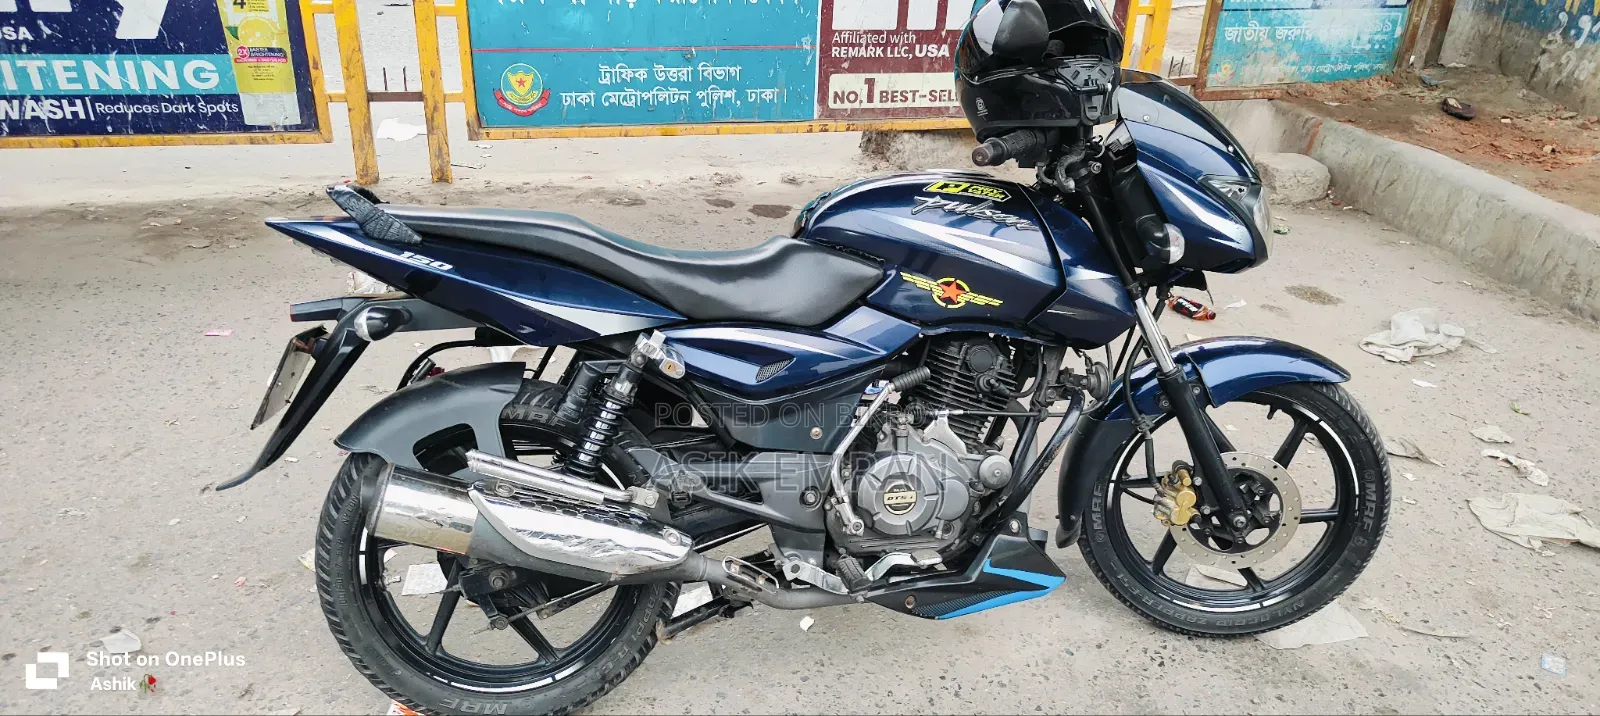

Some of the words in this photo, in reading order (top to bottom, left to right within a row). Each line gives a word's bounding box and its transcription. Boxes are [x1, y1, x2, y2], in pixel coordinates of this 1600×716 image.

[0, 26, 34, 40] SA
[832, 31, 886, 43] Affiliated
[890, 32, 916, 43] with
[237, 48, 249, 56] 2X
[831, 46, 884, 58] REMARK
[887, 46, 913, 60] LLC,
[915, 44, 950, 57] USA
[599, 63, 648, 85] ট্রাফিক
[653, 64, 692, 82] উত্তরা
[698, 62, 742, 81] বিভাগ
[560, 90, 596, 107] ঢাকা
[601, 86, 691, 108] মেট্রোপলিটন
[696, 85, 741, 107] পুলিশ,
[879, 89, 961, 104] BEST-SEL
[95, 102, 159, 114] Reduces
[161, 102, 196, 114] Dark
[198, 101, 239, 116] Spots
[400, 251, 453, 270] 150
[503, 408, 567, 427] MRF
[1092, 481, 1102, 530] MRF
[1363, 482, 1376, 533] MRF
[438, 699, 508, 715] MRF
